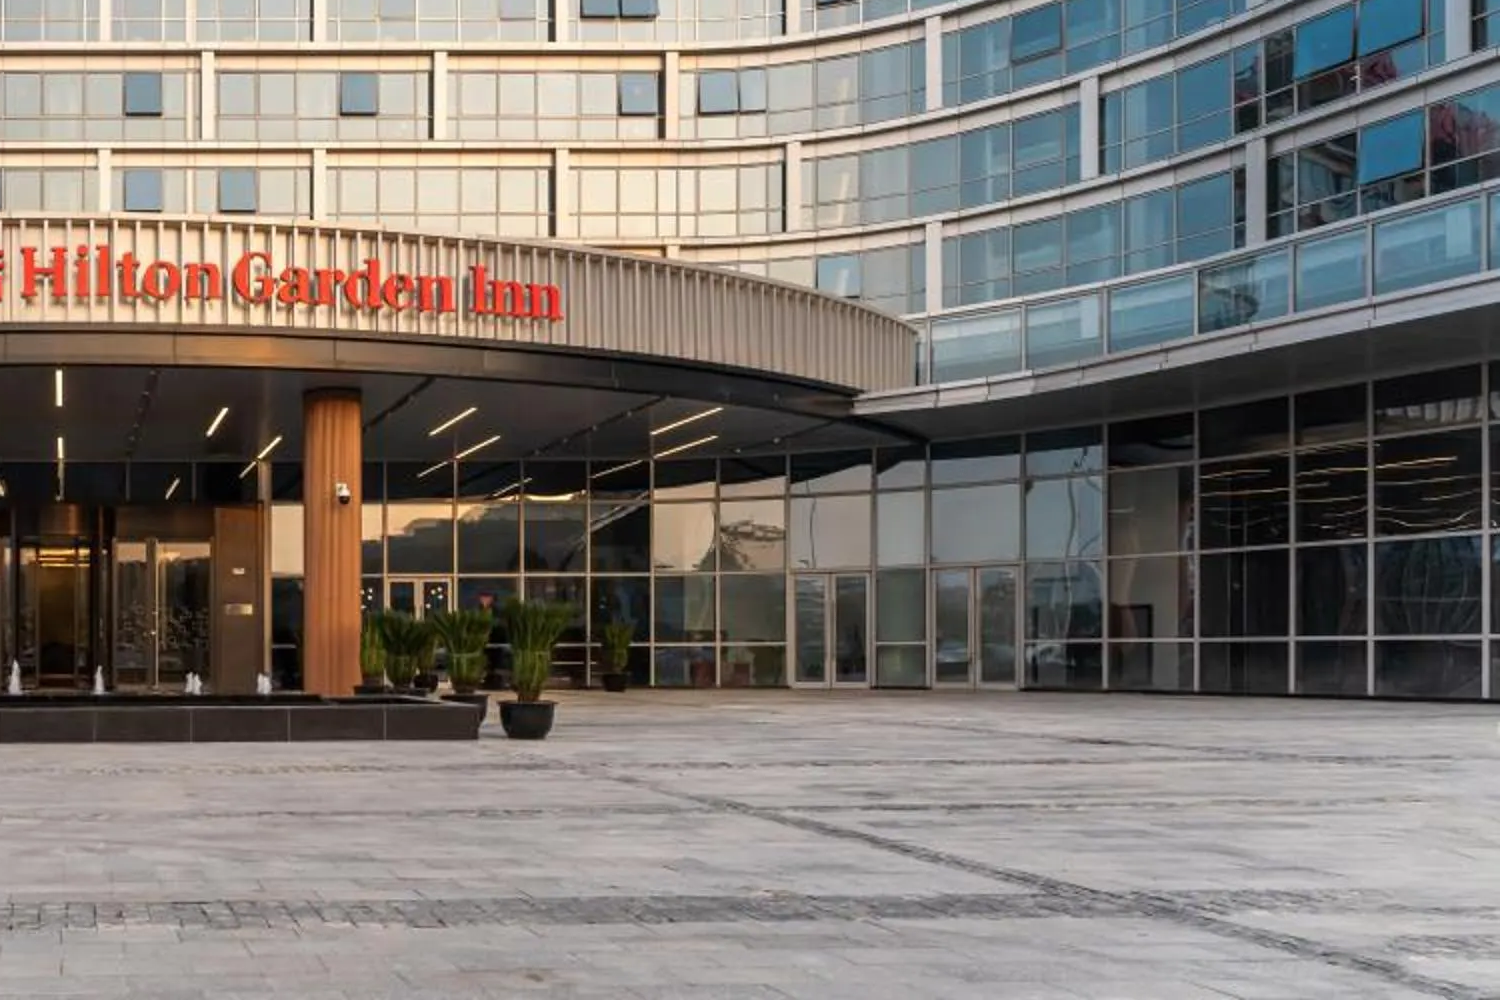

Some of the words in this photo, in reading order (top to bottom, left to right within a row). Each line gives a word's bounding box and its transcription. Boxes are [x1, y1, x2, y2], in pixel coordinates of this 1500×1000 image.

[20, 243, 222, 301] Hilton
[231, 250, 457, 314] Garden
[469, 263, 565, 323] Inn
